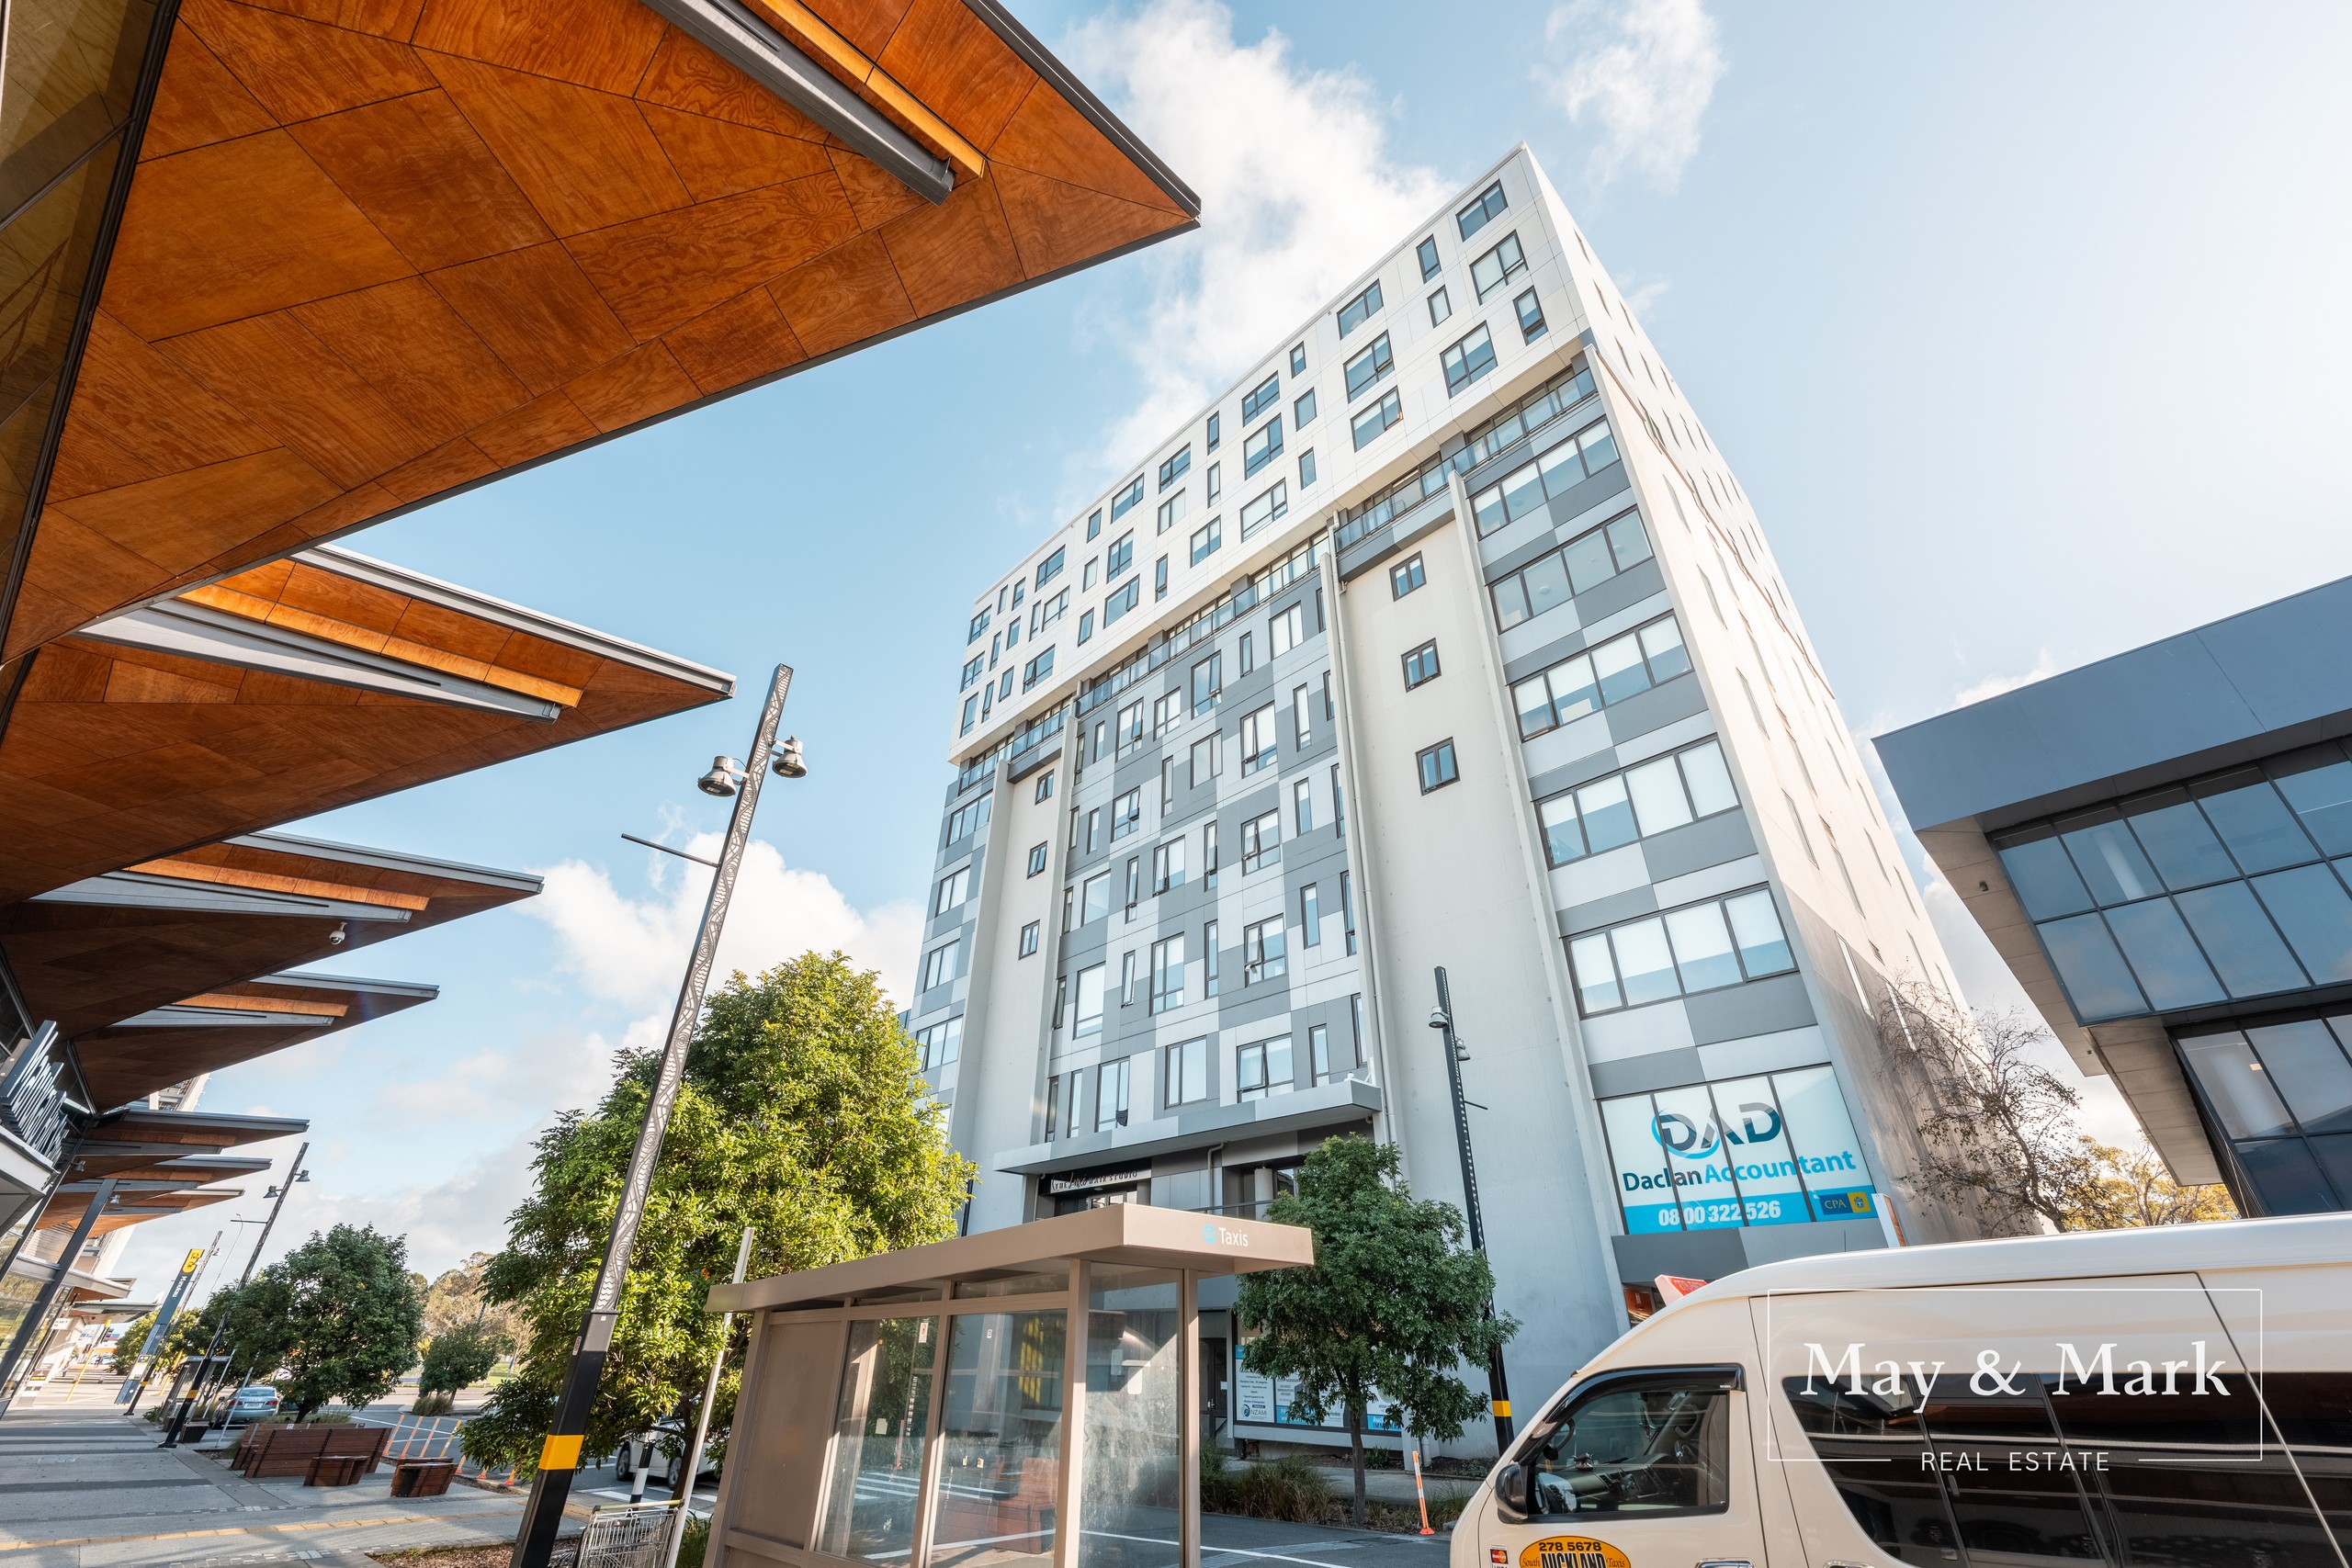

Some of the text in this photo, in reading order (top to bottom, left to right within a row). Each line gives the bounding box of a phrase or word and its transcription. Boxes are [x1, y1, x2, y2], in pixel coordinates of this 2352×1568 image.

[1658, 1101, 1782, 1153] DAD
[1088, 1176, 1107, 1185] HAIR
[1109, 1170, 1137, 1182] STUDIO
[1824, 1199, 1848, 1211] CPA
[1658, 1200, 1781, 1227] 0800 322 526
[1218, 1226, 1249, 1247] Taxis
[1538, 1541, 1602, 1551] 278 5678
[1522, 1557, 1541, 1567] South
[1607, 1558, 1625, 1568] Taxis
